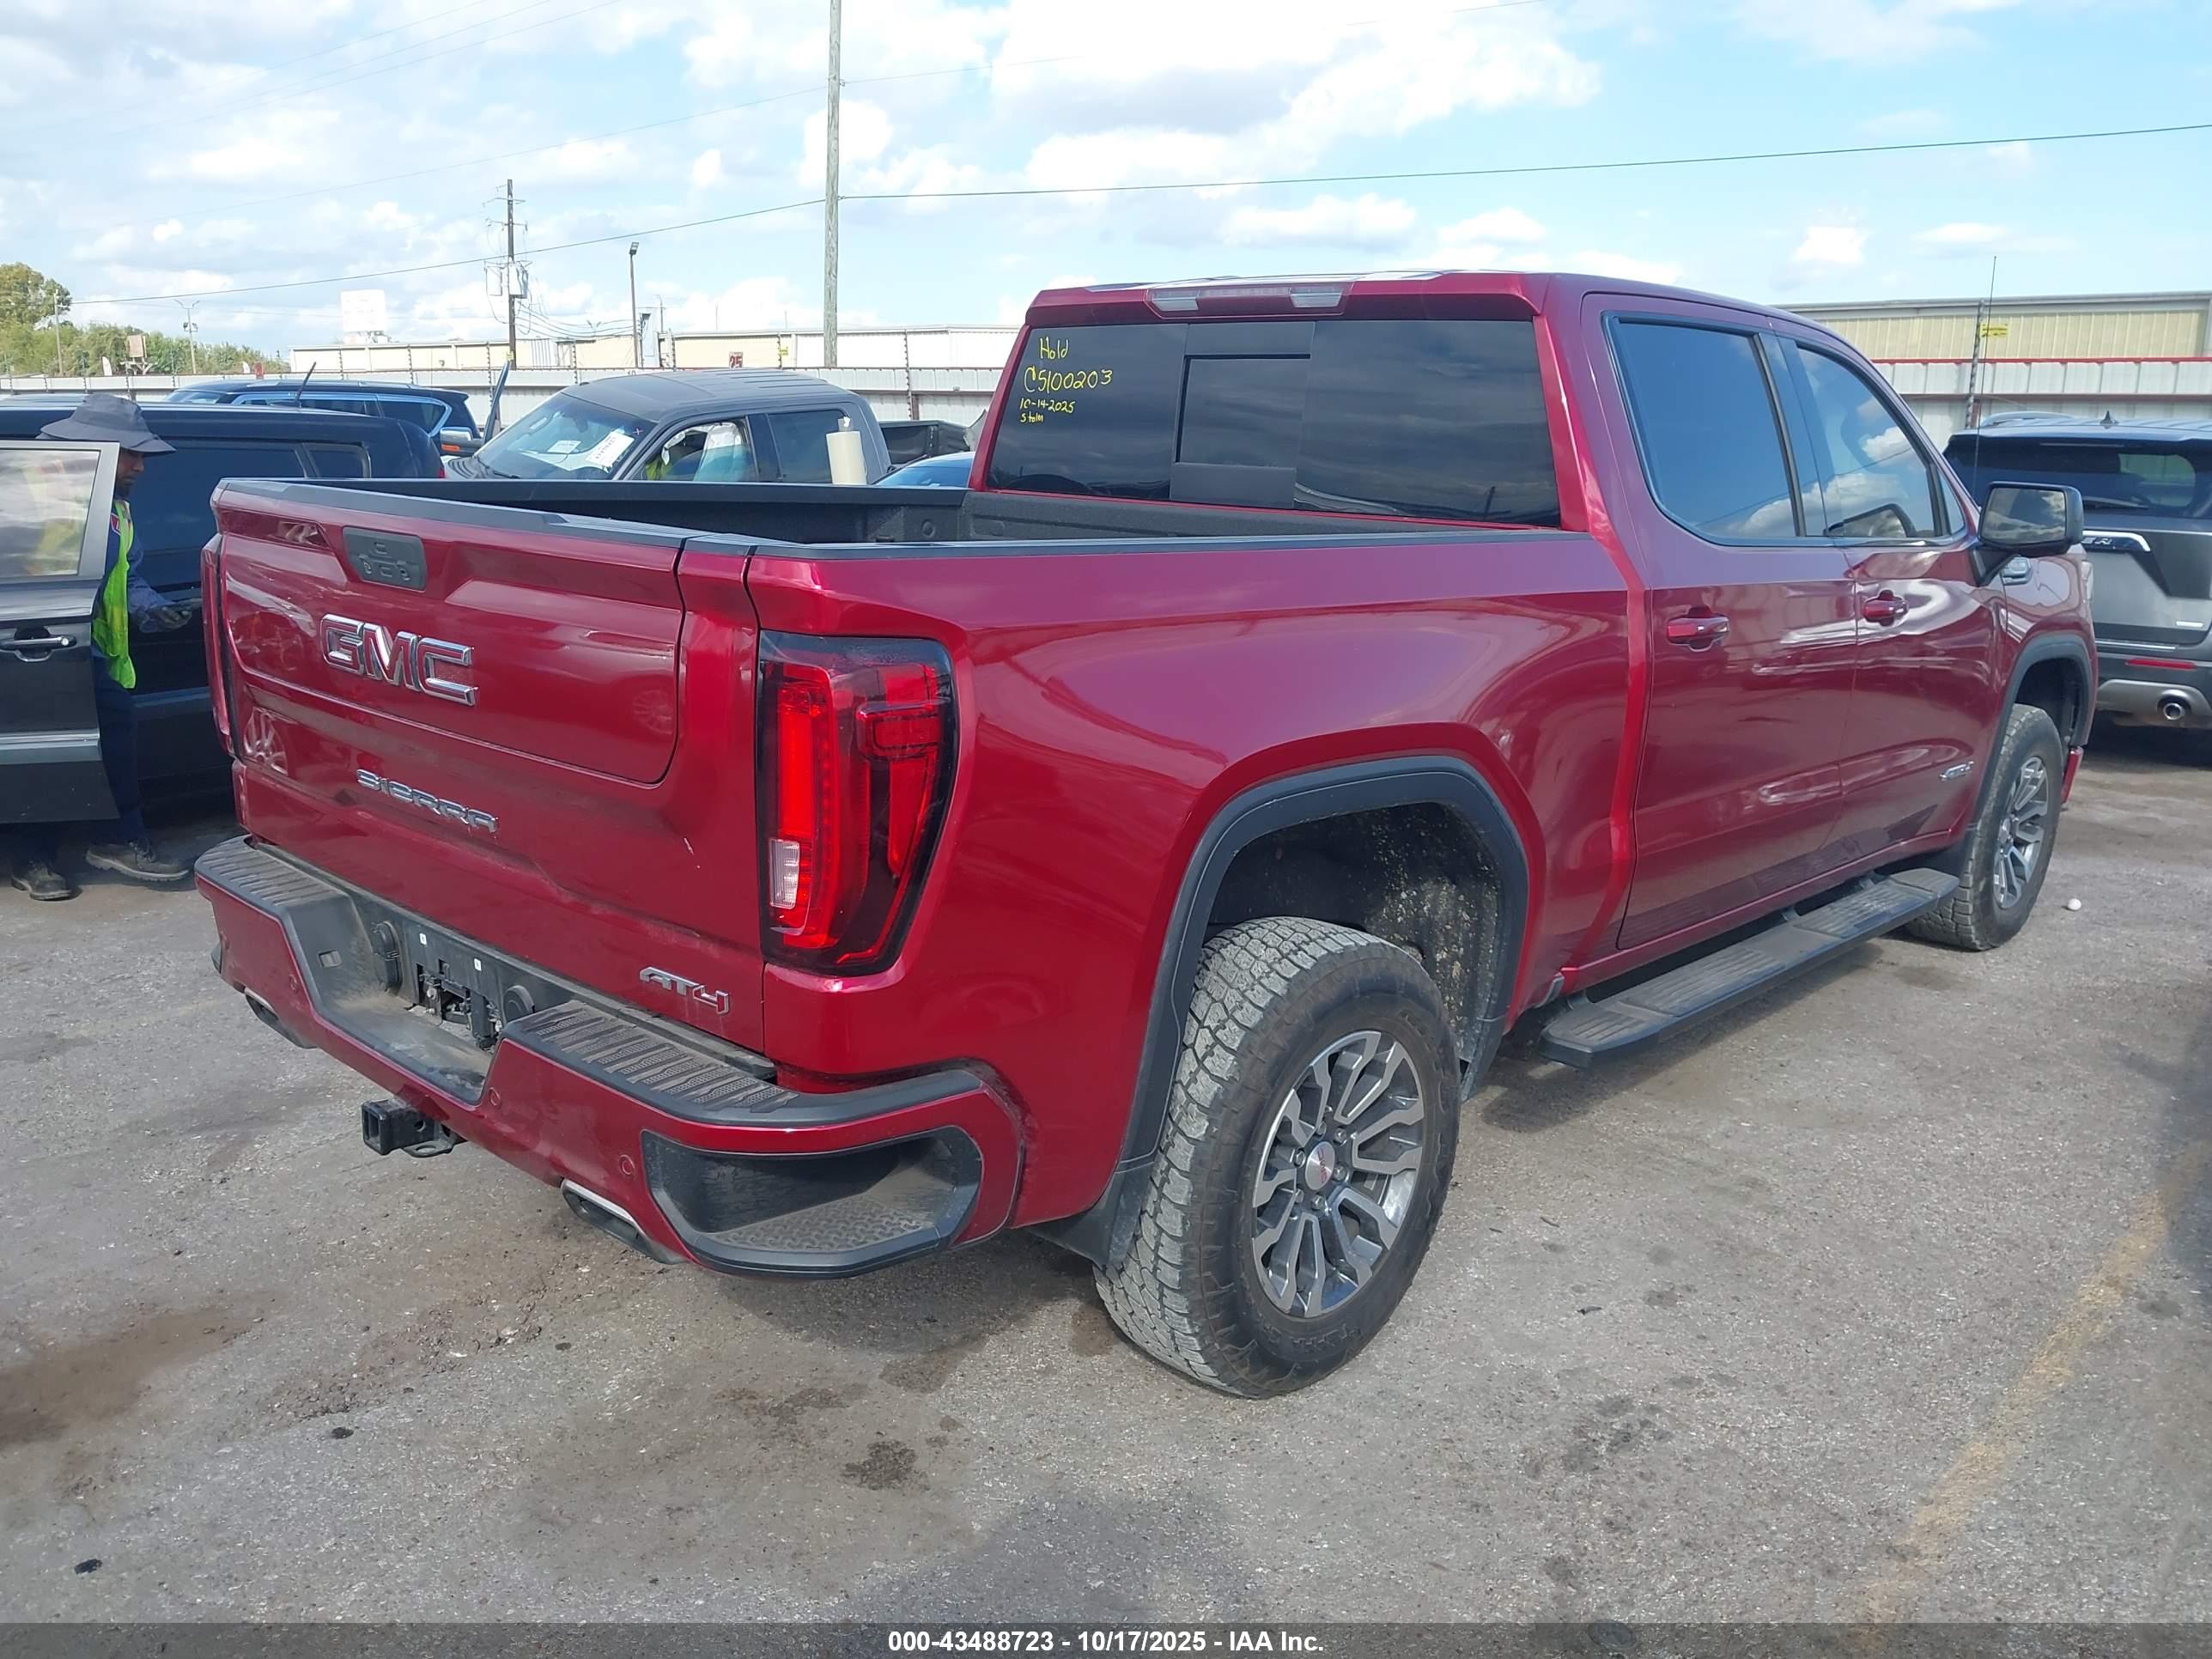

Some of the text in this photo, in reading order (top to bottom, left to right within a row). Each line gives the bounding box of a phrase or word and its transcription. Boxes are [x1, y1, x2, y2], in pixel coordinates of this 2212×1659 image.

[1039, 336, 1069, 360] Hold
[1024, 365, 1113, 394] C5100203
[1019, 397, 1076, 414] 10-14-2025
[320, 613, 477, 707] GMC
[357, 769, 497, 834] SIERRA
[639, 966, 729, 1014] AT4
